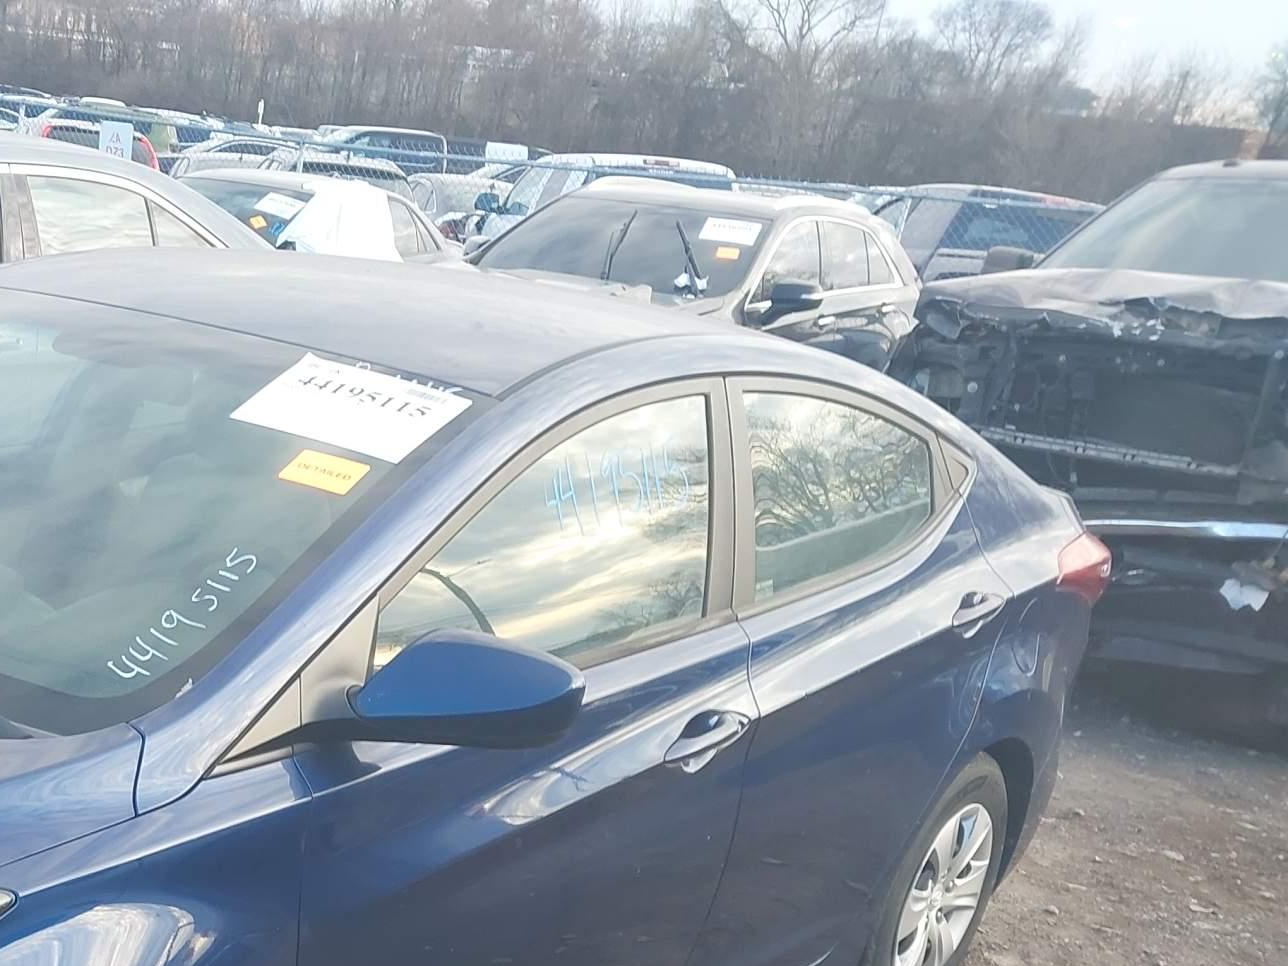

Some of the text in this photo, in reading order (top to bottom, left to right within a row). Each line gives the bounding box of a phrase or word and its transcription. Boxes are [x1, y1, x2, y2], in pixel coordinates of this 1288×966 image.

[299, 375, 432, 418] 44195115
[107, 547, 257, 678] 4419 5115
